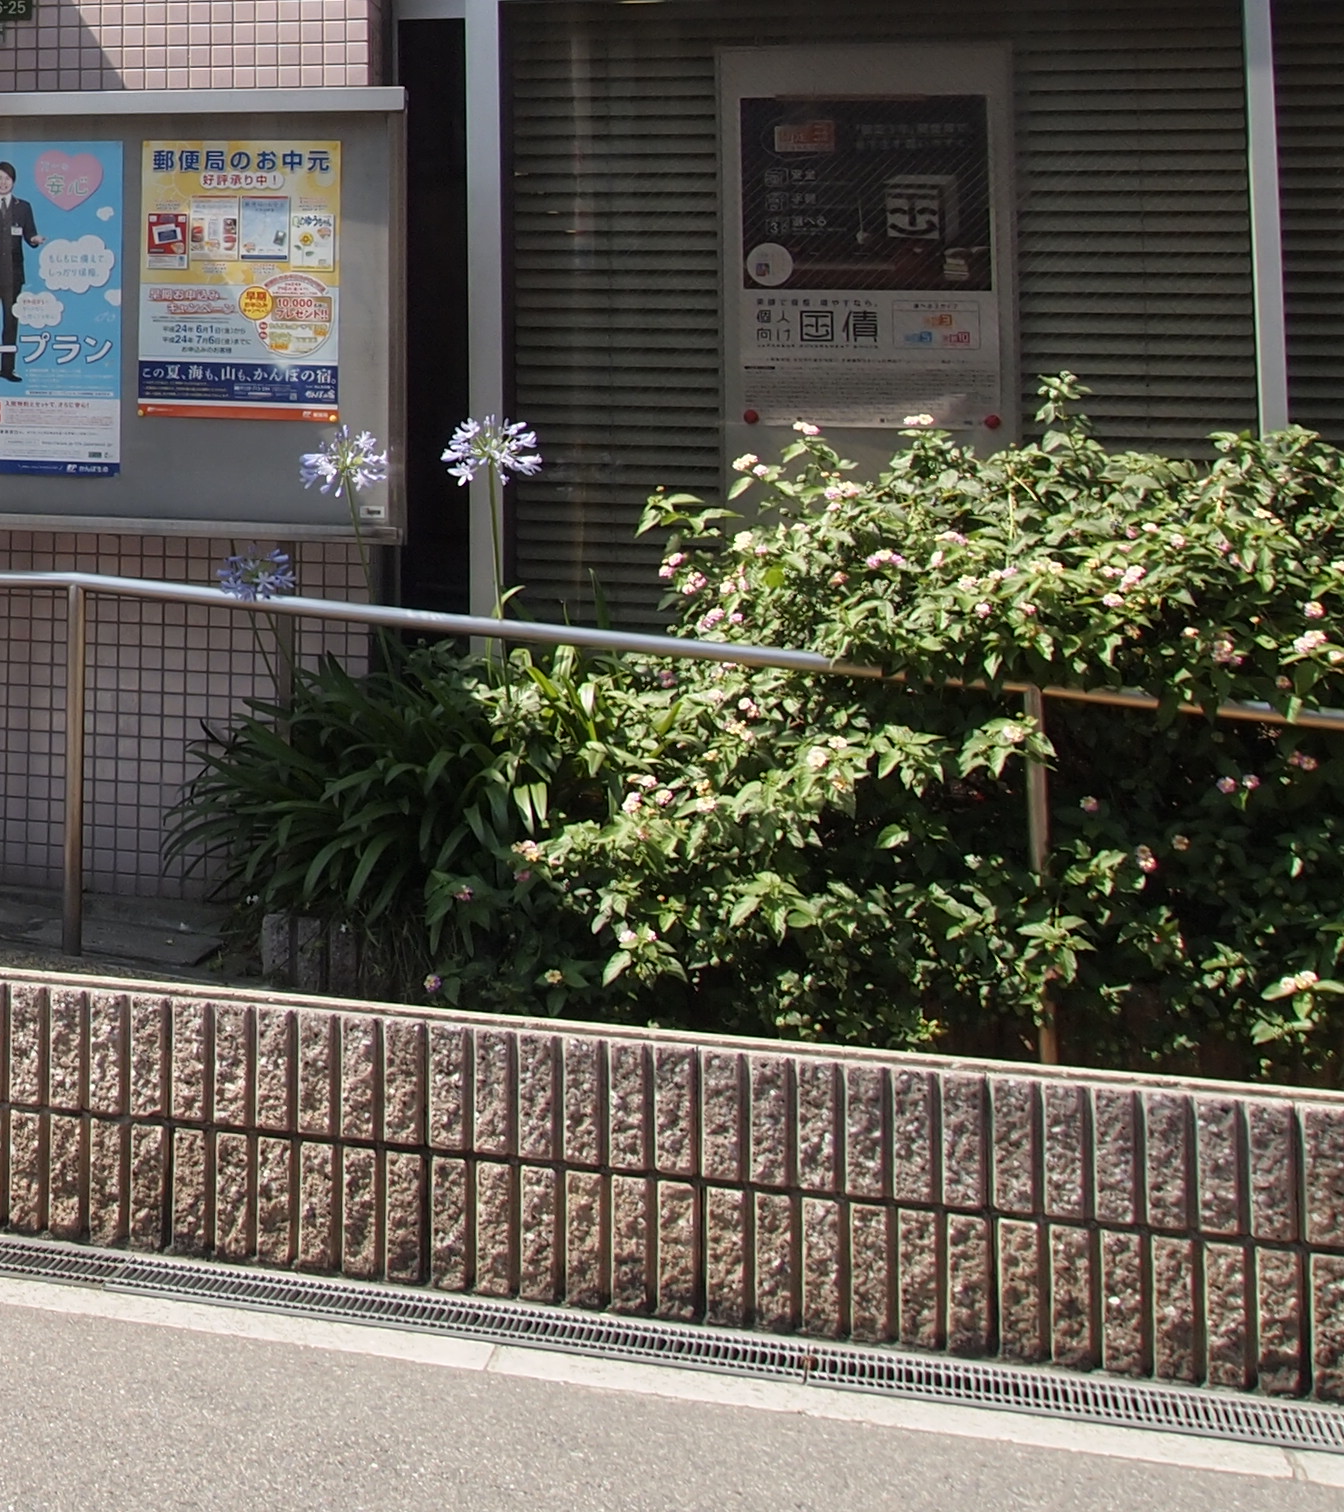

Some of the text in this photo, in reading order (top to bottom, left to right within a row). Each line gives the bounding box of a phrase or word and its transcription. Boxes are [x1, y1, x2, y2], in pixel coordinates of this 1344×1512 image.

[152, 149, 330, 172] 郵便局のお中元
[46, 175, 89, 196] 安心
[148, 288, 221, 302] 早期お申込み
[245, 291, 268, 301] 早期
[166, 302, 236, 315] キャンペーン
[756, 309, 790, 324] 個人
[756, 327, 791, 342] 向け
